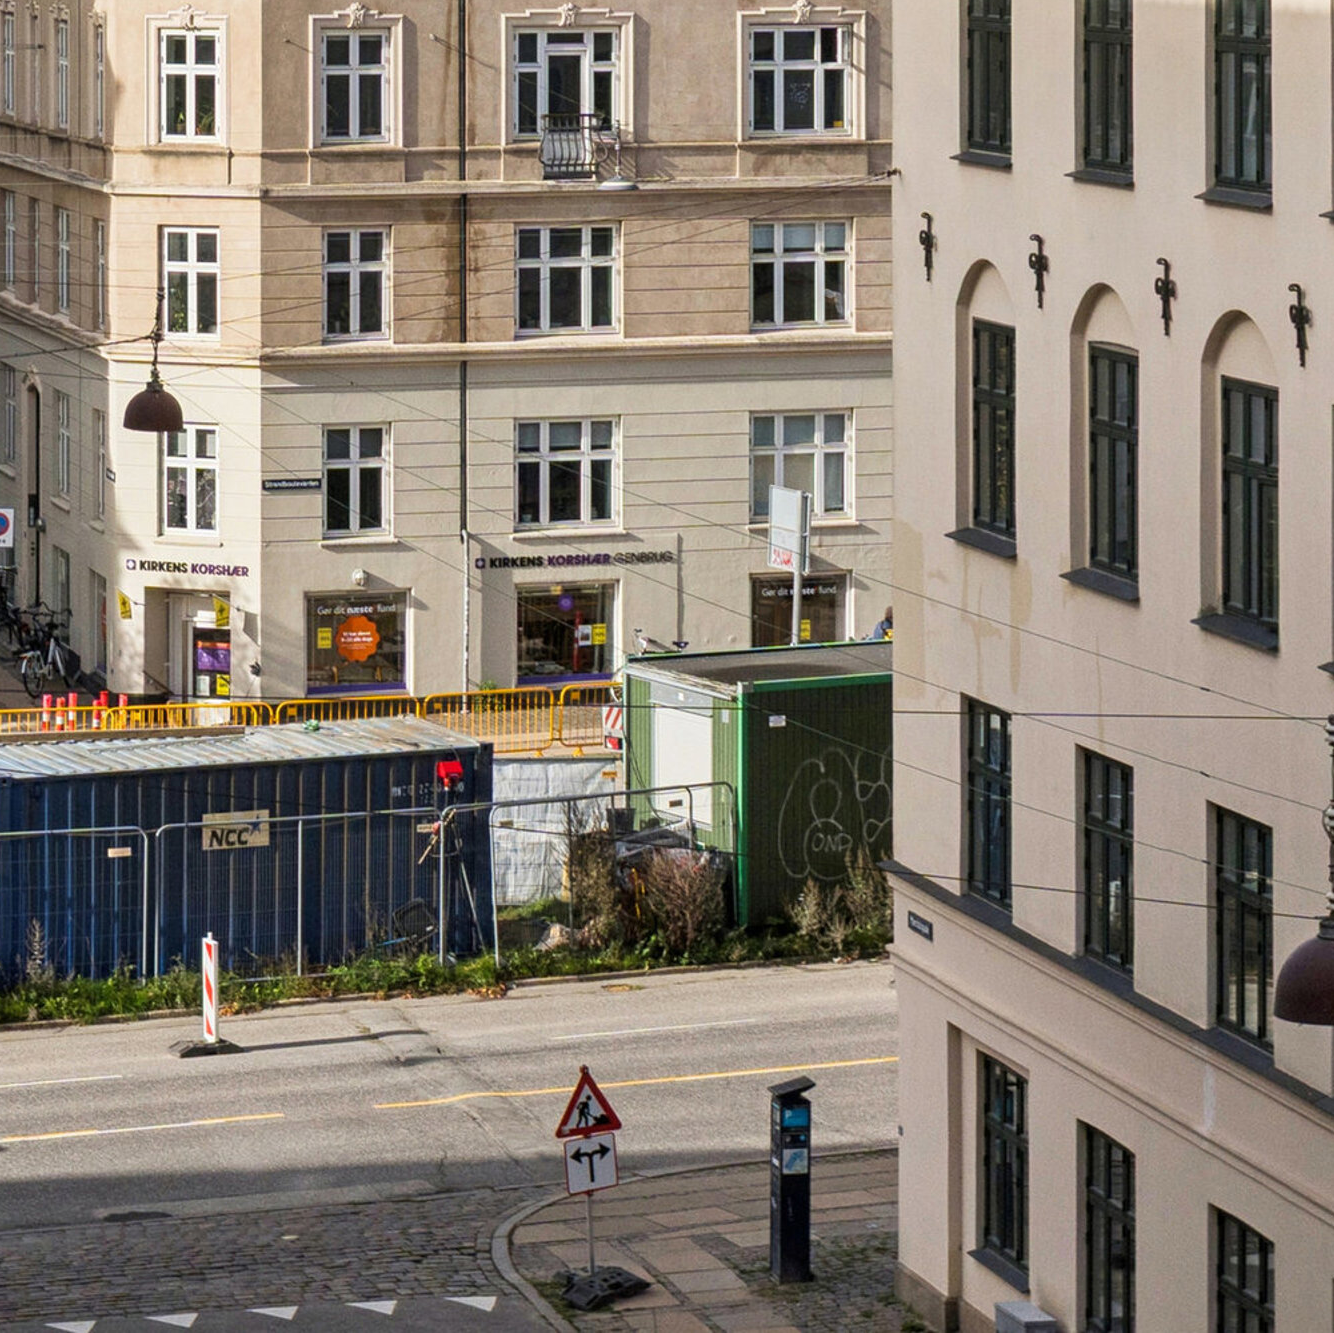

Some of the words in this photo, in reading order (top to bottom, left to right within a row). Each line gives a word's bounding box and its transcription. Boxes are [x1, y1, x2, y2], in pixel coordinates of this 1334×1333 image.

[489, 555, 543, 568] KIRKENS
[547, 553, 611, 566] KORSHÆR
[613, 550, 674, 564] GENBRUG
[139, 560, 188, 574] KIRKENS
[191, 563, 249, 577] KORSHÆR
[210, 827, 249, 847] NCC
